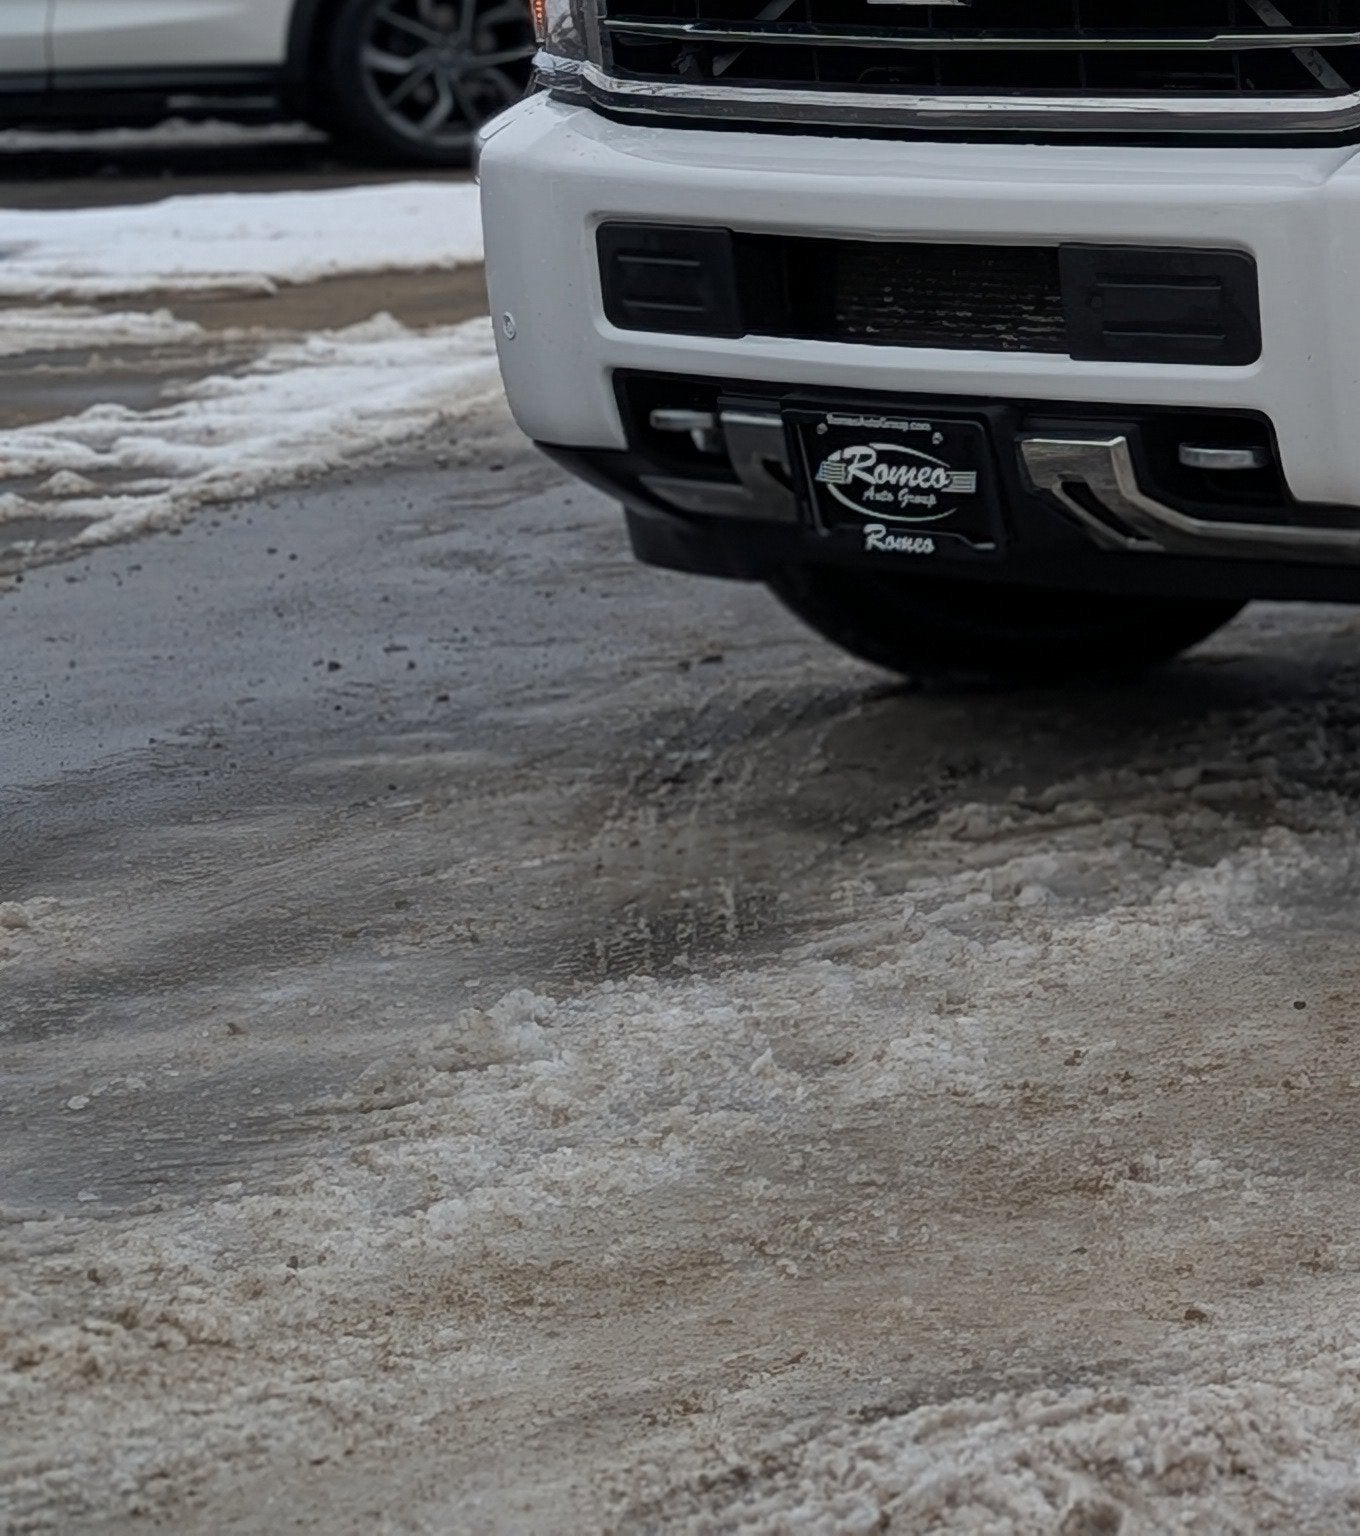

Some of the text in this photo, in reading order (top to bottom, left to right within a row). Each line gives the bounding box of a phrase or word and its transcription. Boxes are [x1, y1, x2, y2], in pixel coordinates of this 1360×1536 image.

[842, 445, 950, 489] Romeo
[862, 485, 937, 509] Auto Group
[862, 523, 936, 555] Romeo
